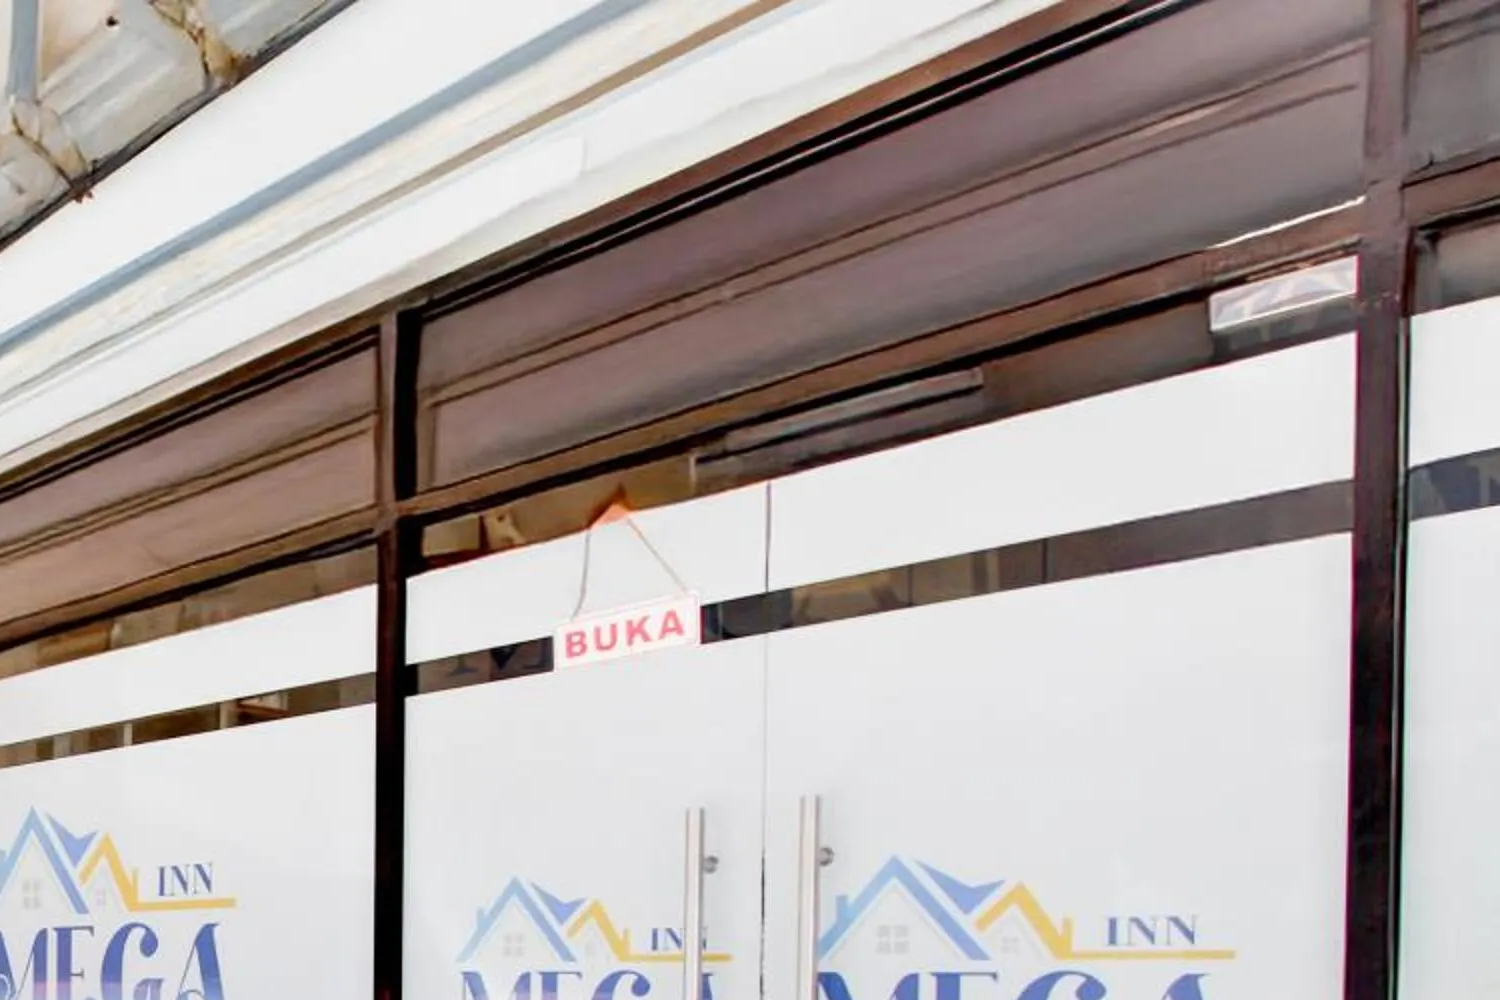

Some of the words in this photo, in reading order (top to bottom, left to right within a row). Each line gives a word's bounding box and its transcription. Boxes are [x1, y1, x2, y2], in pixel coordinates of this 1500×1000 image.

[565, 609, 684, 658] BUKA
[157, 862, 213, 897] INN
[1104, 914, 1199, 947] INN
